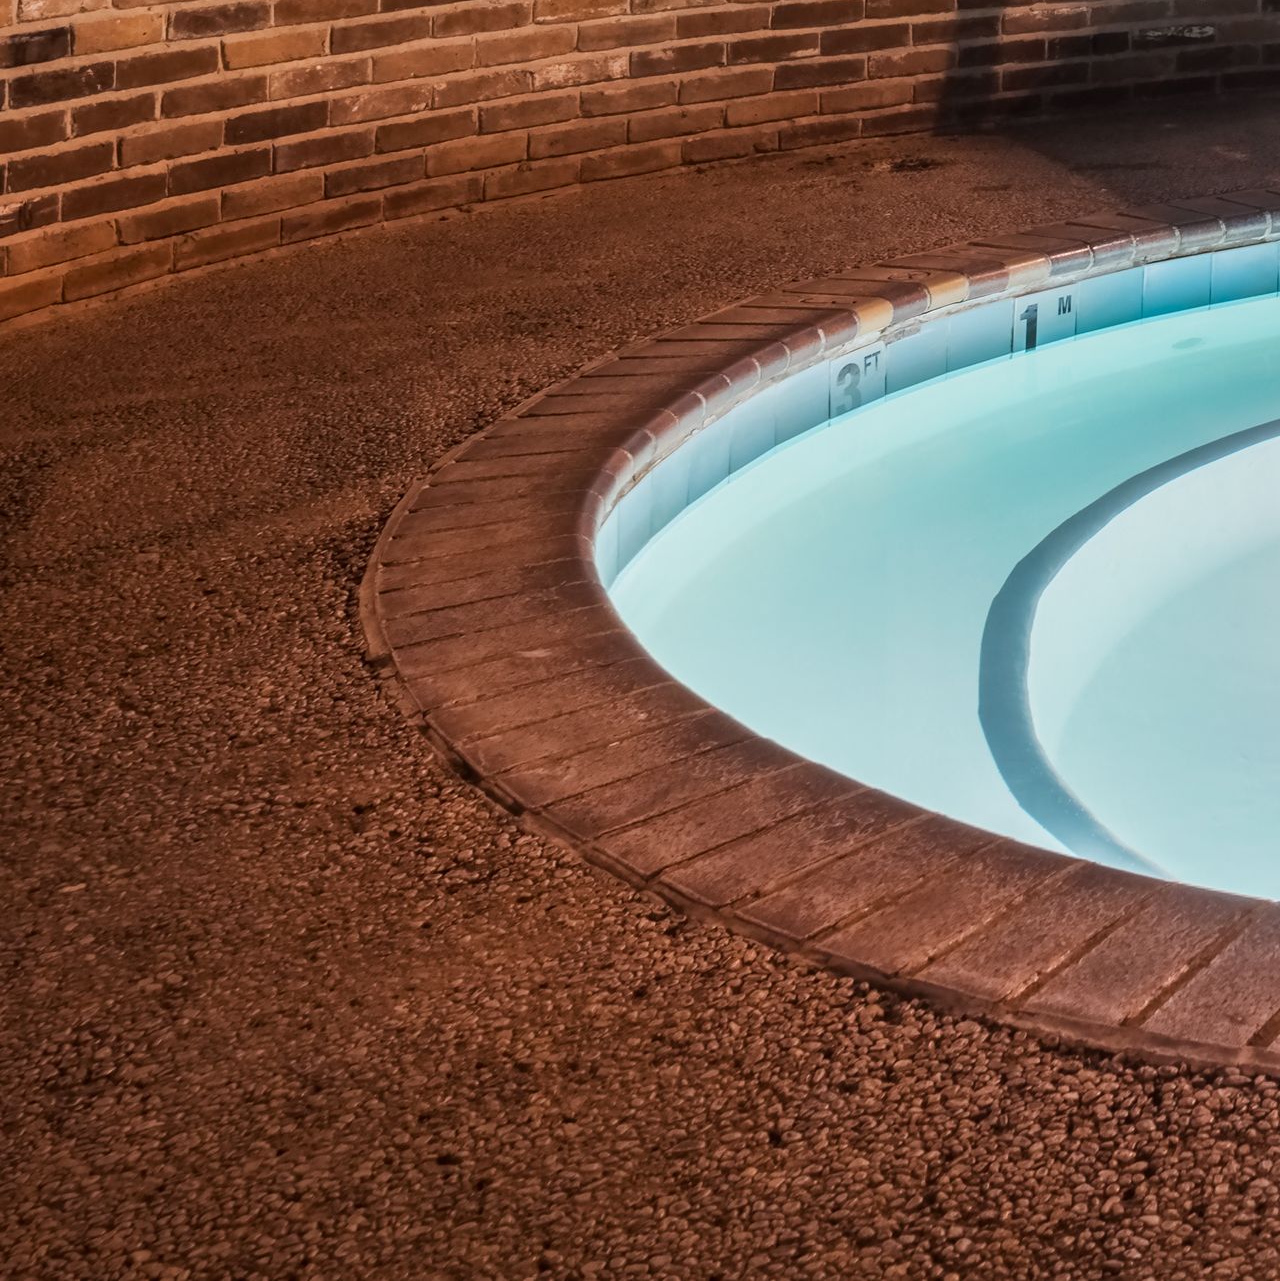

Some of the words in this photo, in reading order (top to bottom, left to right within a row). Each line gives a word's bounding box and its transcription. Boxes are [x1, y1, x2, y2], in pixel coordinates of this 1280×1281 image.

[1020, 303, 1038, 353] 1
[1057, 295, 1072, 316] M
[836, 363, 862, 415] 3
[864, 350, 881, 375] FT
